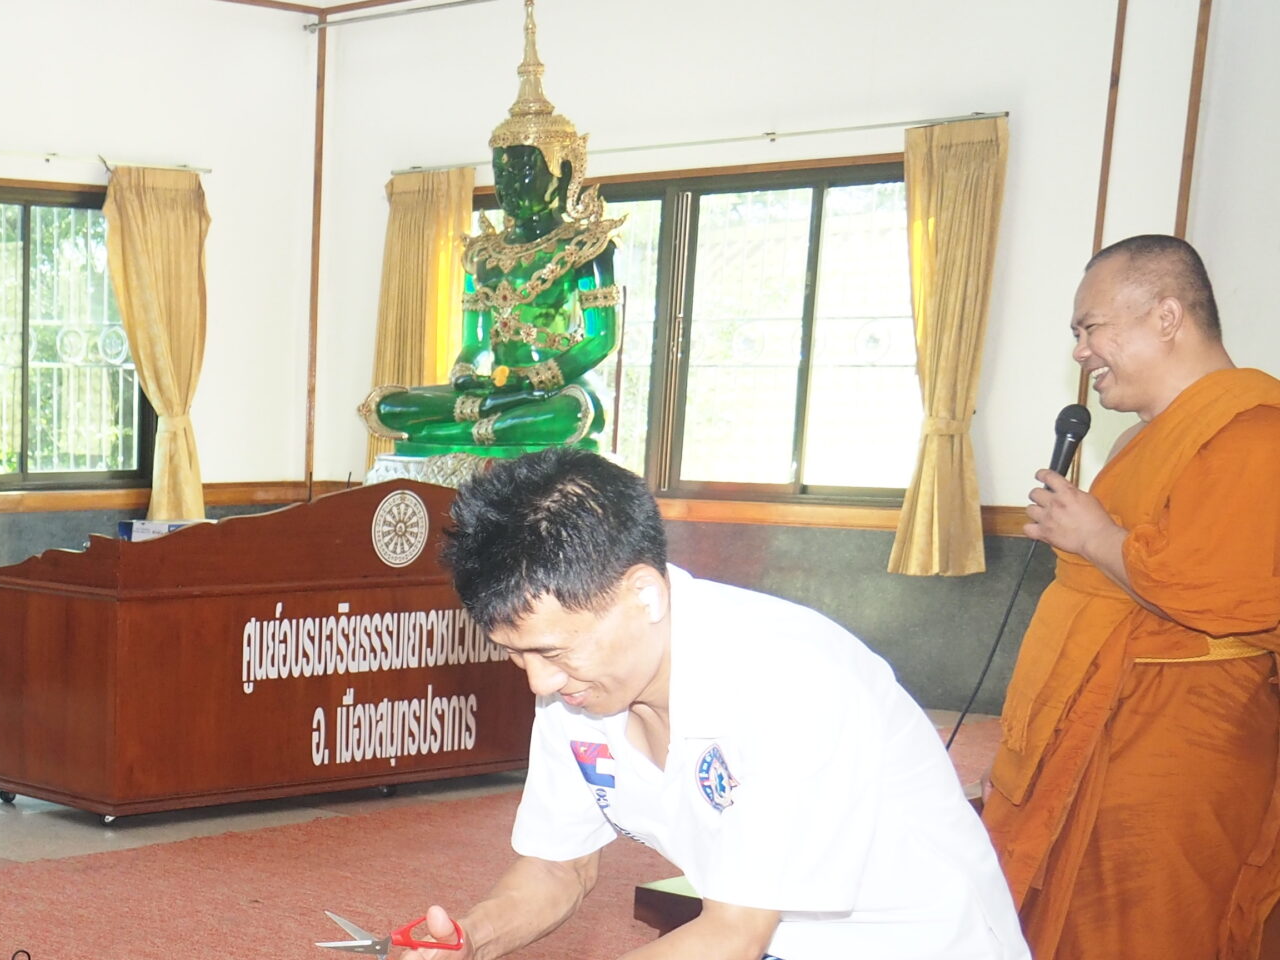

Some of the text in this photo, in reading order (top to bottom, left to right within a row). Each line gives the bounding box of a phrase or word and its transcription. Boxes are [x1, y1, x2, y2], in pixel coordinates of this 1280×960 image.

[312, 684, 477, 767] อ. เมืองสมุทรปราการ
